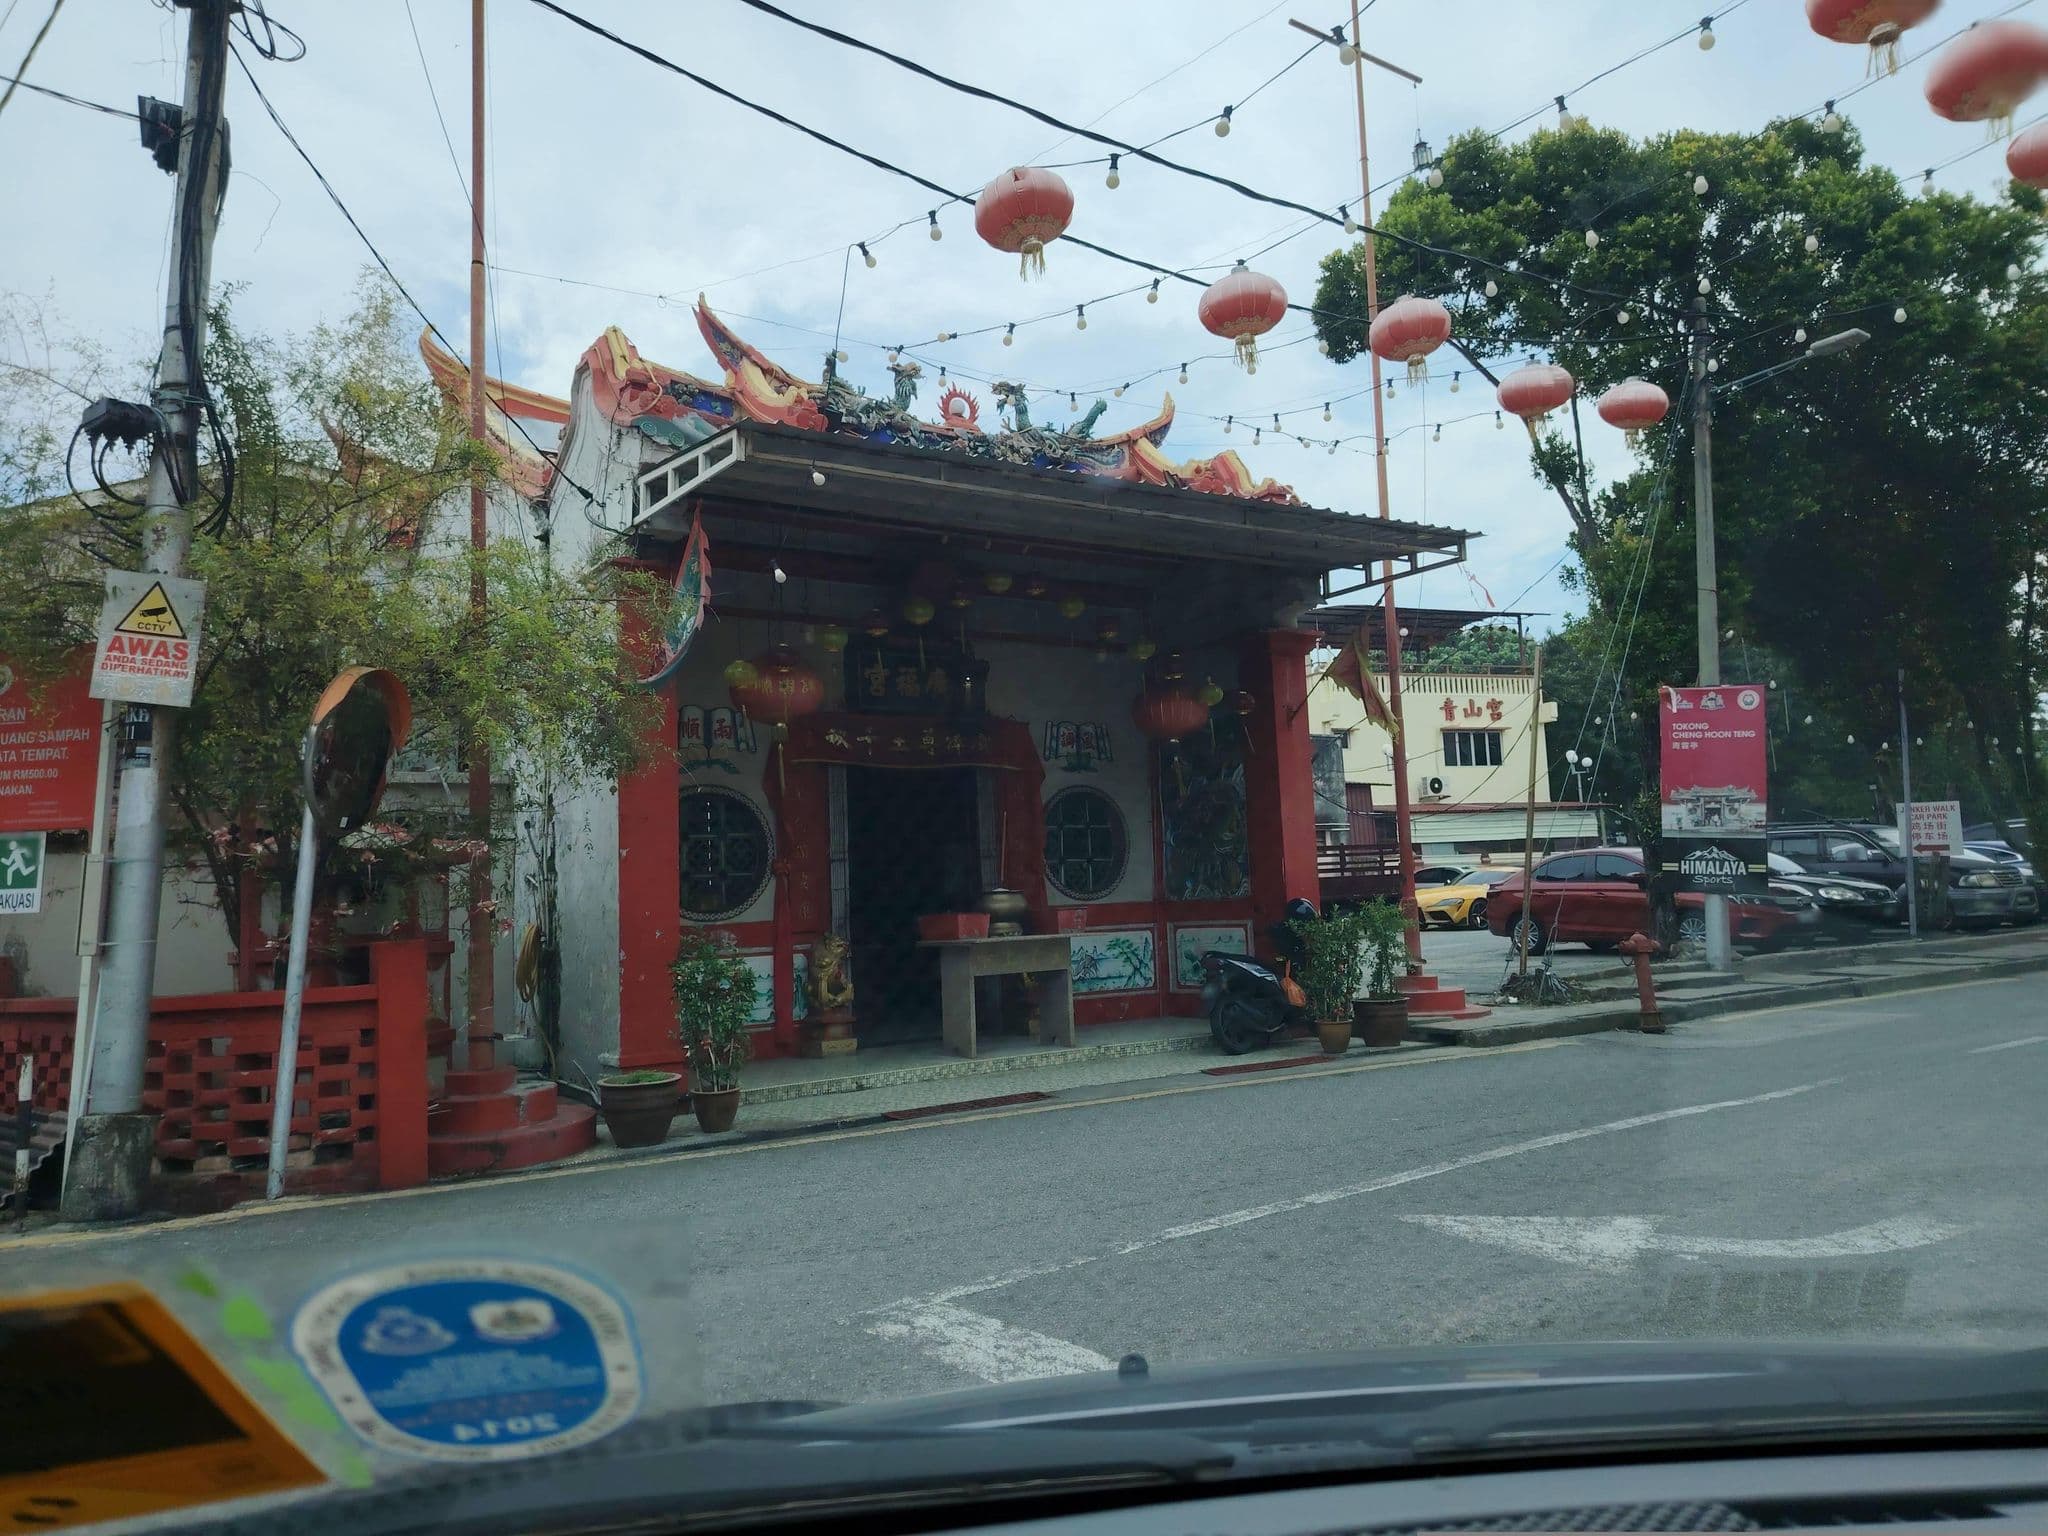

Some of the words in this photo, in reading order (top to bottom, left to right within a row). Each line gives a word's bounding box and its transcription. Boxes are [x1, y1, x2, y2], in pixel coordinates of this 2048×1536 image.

[137, 622, 166, 632] CCTV
[107, 635, 189, 661] AWAS
[105, 655, 137, 666] ANDA
[140, 658, 188, 670] SEDANG
[101, 662, 189, 679] DIPERHATIKAN
[1672, 722, 1709, 731] TOKONG
[38, 728, 90, 742] SAMPAH
[1672, 731, 1703, 739] CHENG
[1733, 730, 1756, 738] TENG
[0, 751, 17, 762] TA
[21, 747, 69, 760] TEMPAT.
[13, 768, 58, 780] RM500.00
[1901, 804, 1930, 813] JNKER
[1933, 804, 1956, 812] WALK
[1681, 859, 1747, 876] HIMALAYA
[1692, 874, 1734, 886] Sports
